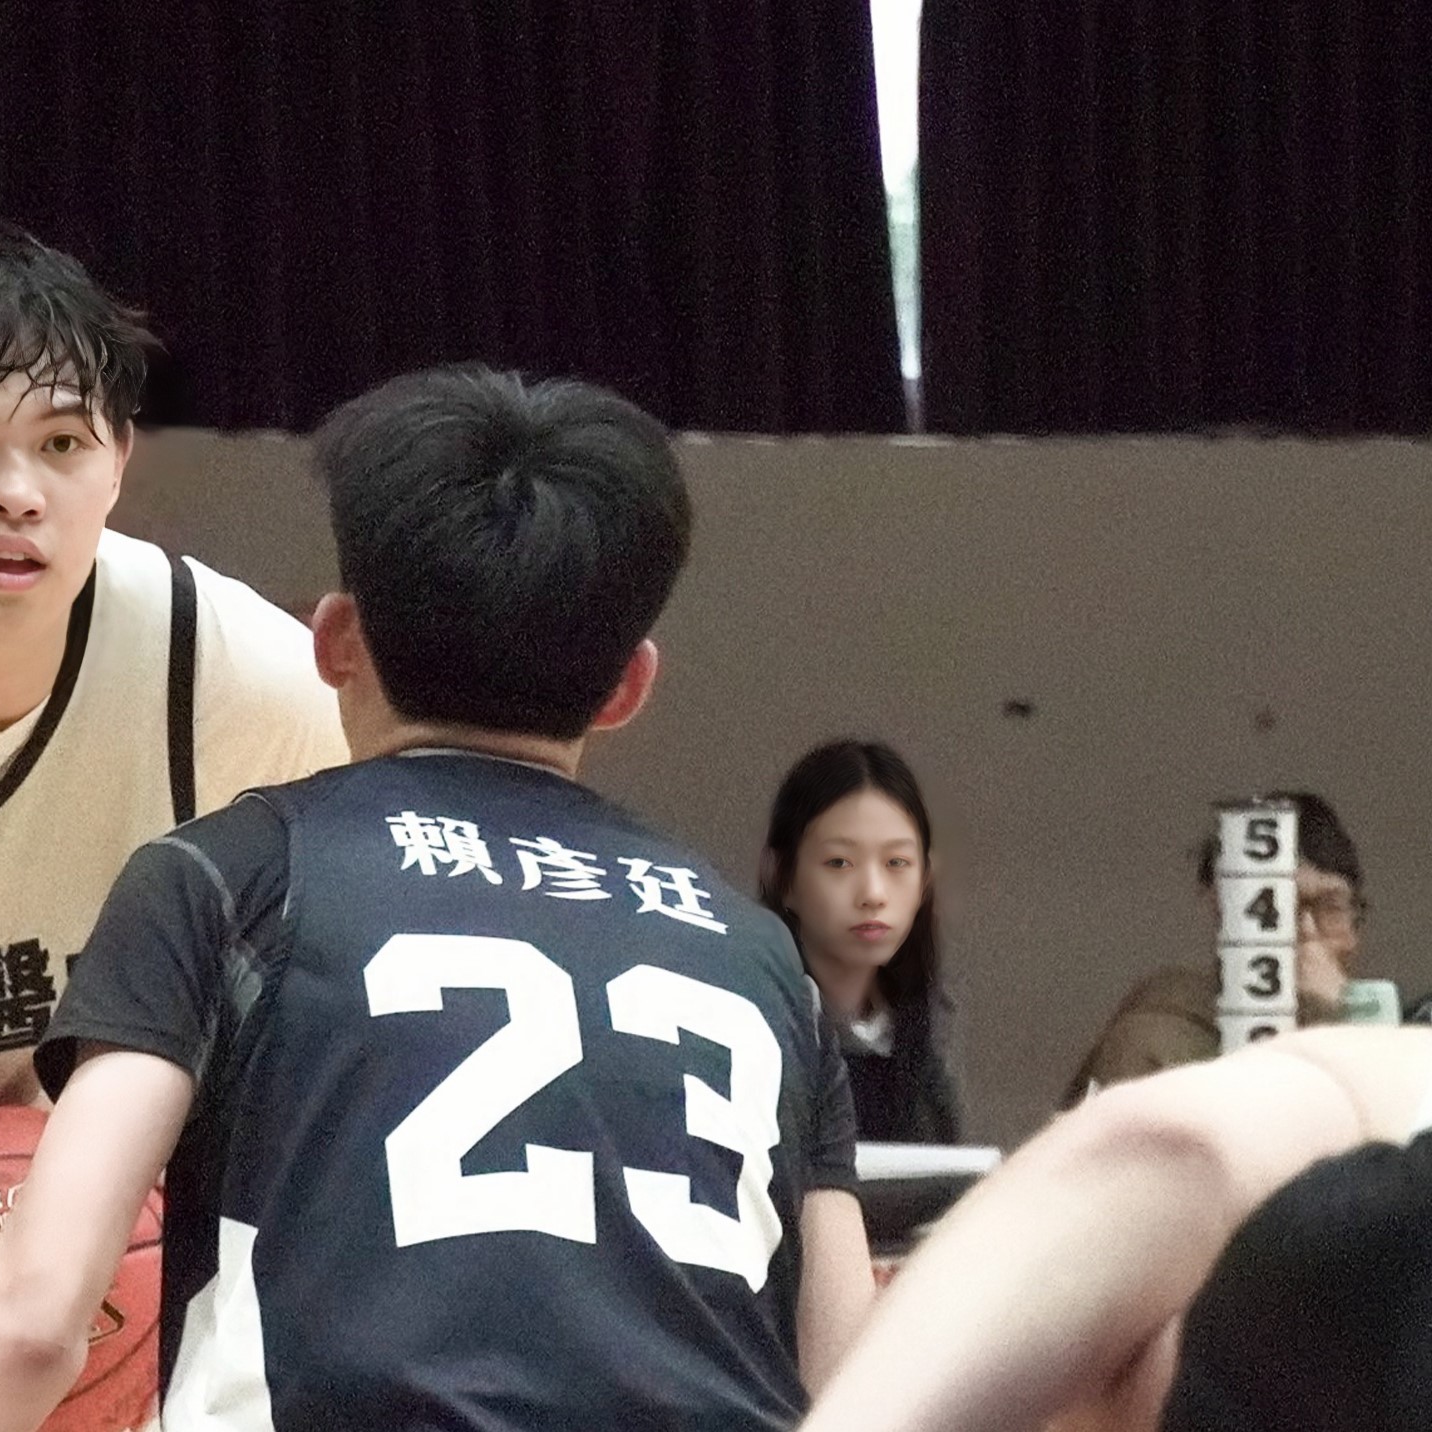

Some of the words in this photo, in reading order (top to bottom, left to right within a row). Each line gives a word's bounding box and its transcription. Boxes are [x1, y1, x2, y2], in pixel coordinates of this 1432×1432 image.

[1243, 818, 1279, 861] 5
[385, 810, 729, 935] 賴彥廷
[1244, 887, 1279, 932] 4
[1244, 956, 1281, 999] 3
[363, 933, 783, 1293] 23
